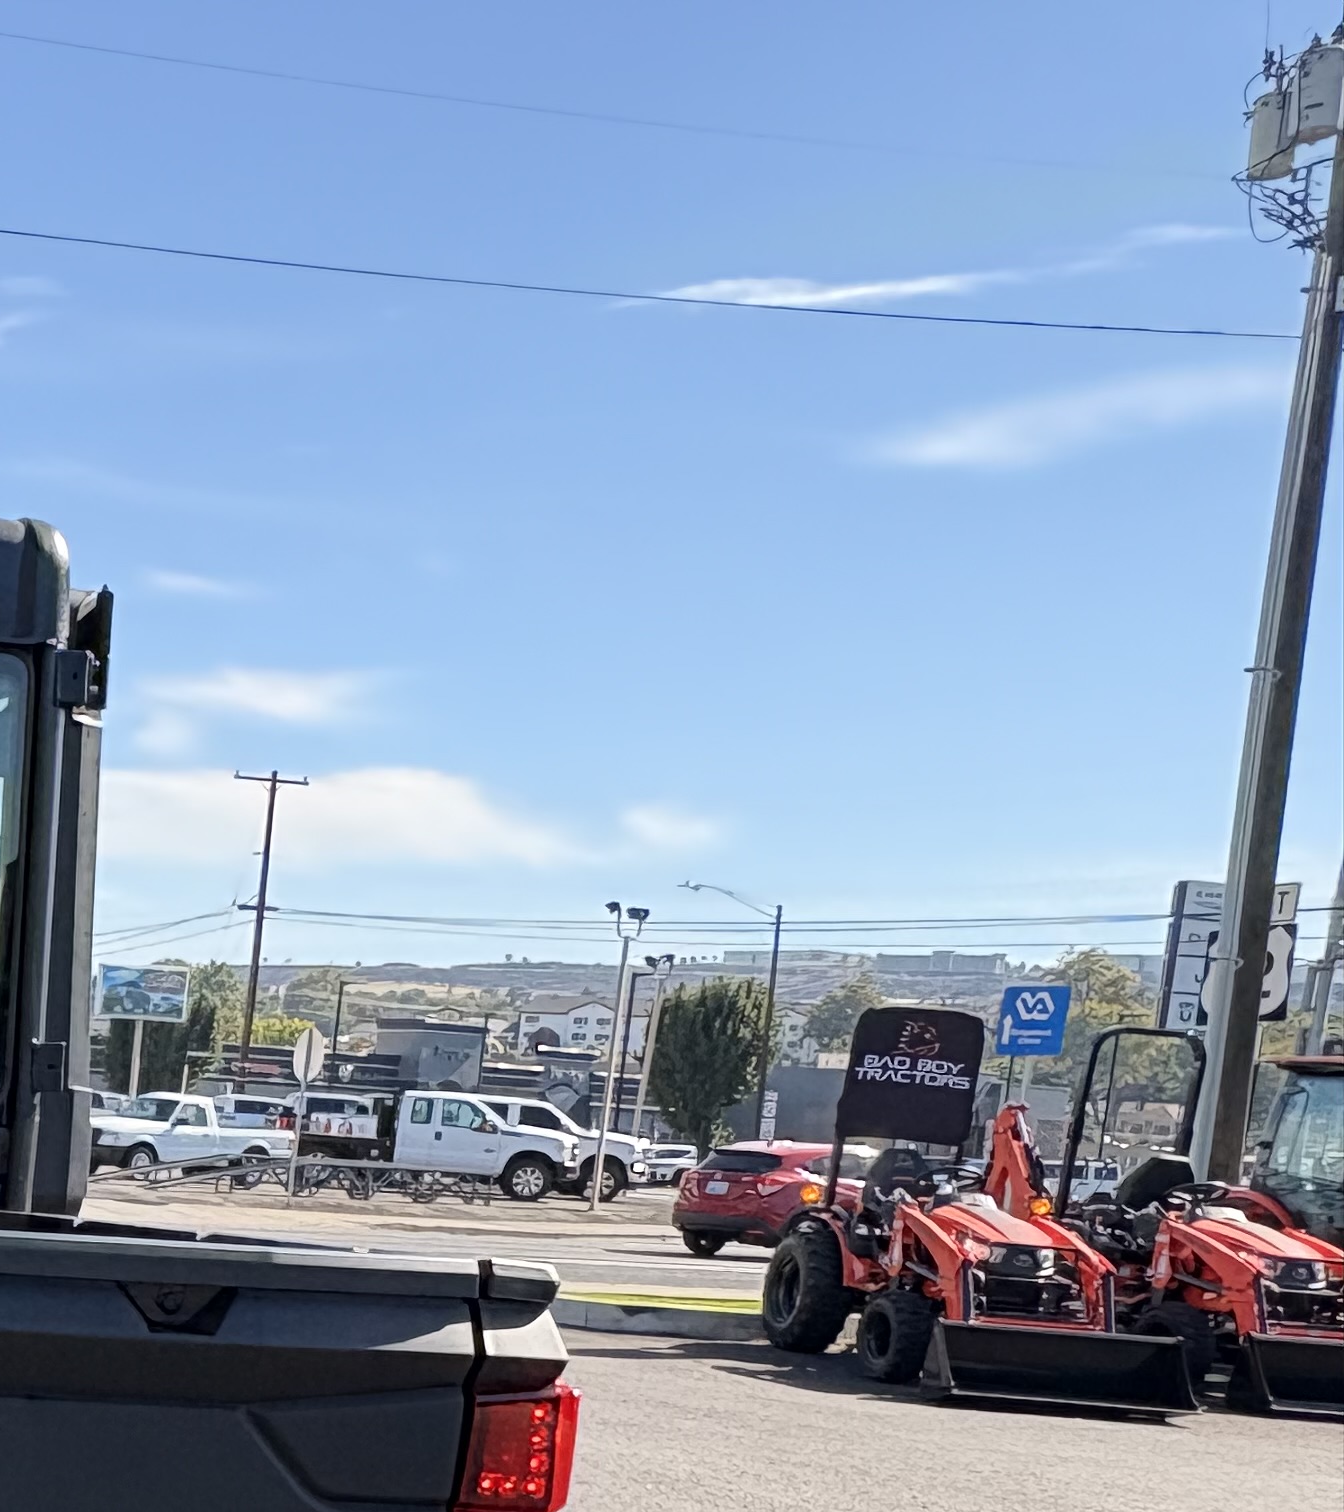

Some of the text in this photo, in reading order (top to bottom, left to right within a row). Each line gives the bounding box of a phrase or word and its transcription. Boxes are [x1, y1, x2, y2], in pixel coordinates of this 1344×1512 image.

[864, 1054, 965, 1075] BAD BOY
[855, 1066, 972, 1089] TRACTORS
